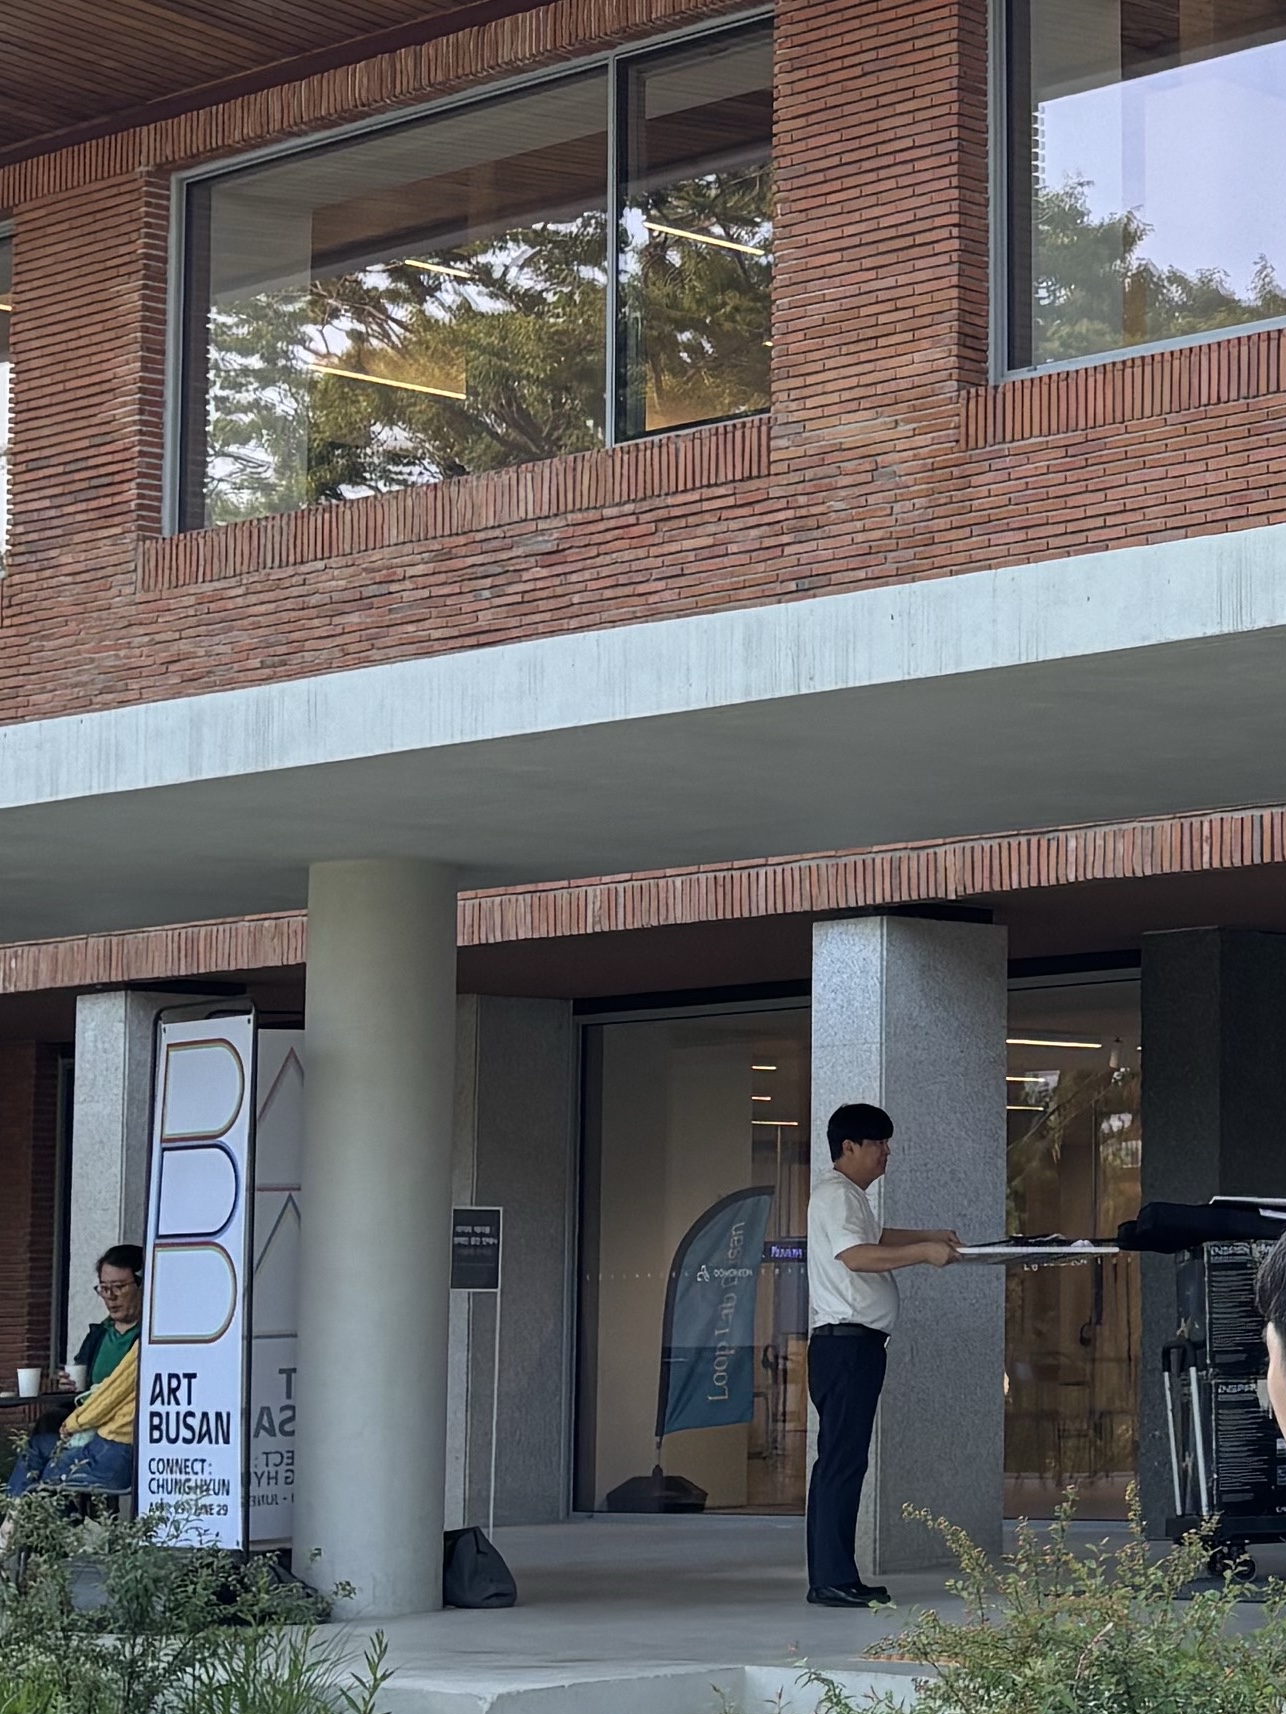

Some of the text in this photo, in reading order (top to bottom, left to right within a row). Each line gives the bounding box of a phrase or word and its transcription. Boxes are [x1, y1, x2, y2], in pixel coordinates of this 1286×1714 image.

[150, 1372, 197, 1406] ART
[707, 1342, 736, 1402] Loop
[149, 1411, 231, 1445] BUSAN
[148, 1458, 213, 1476] CONNECT:
[216, 1504, 229, 1516] 29
